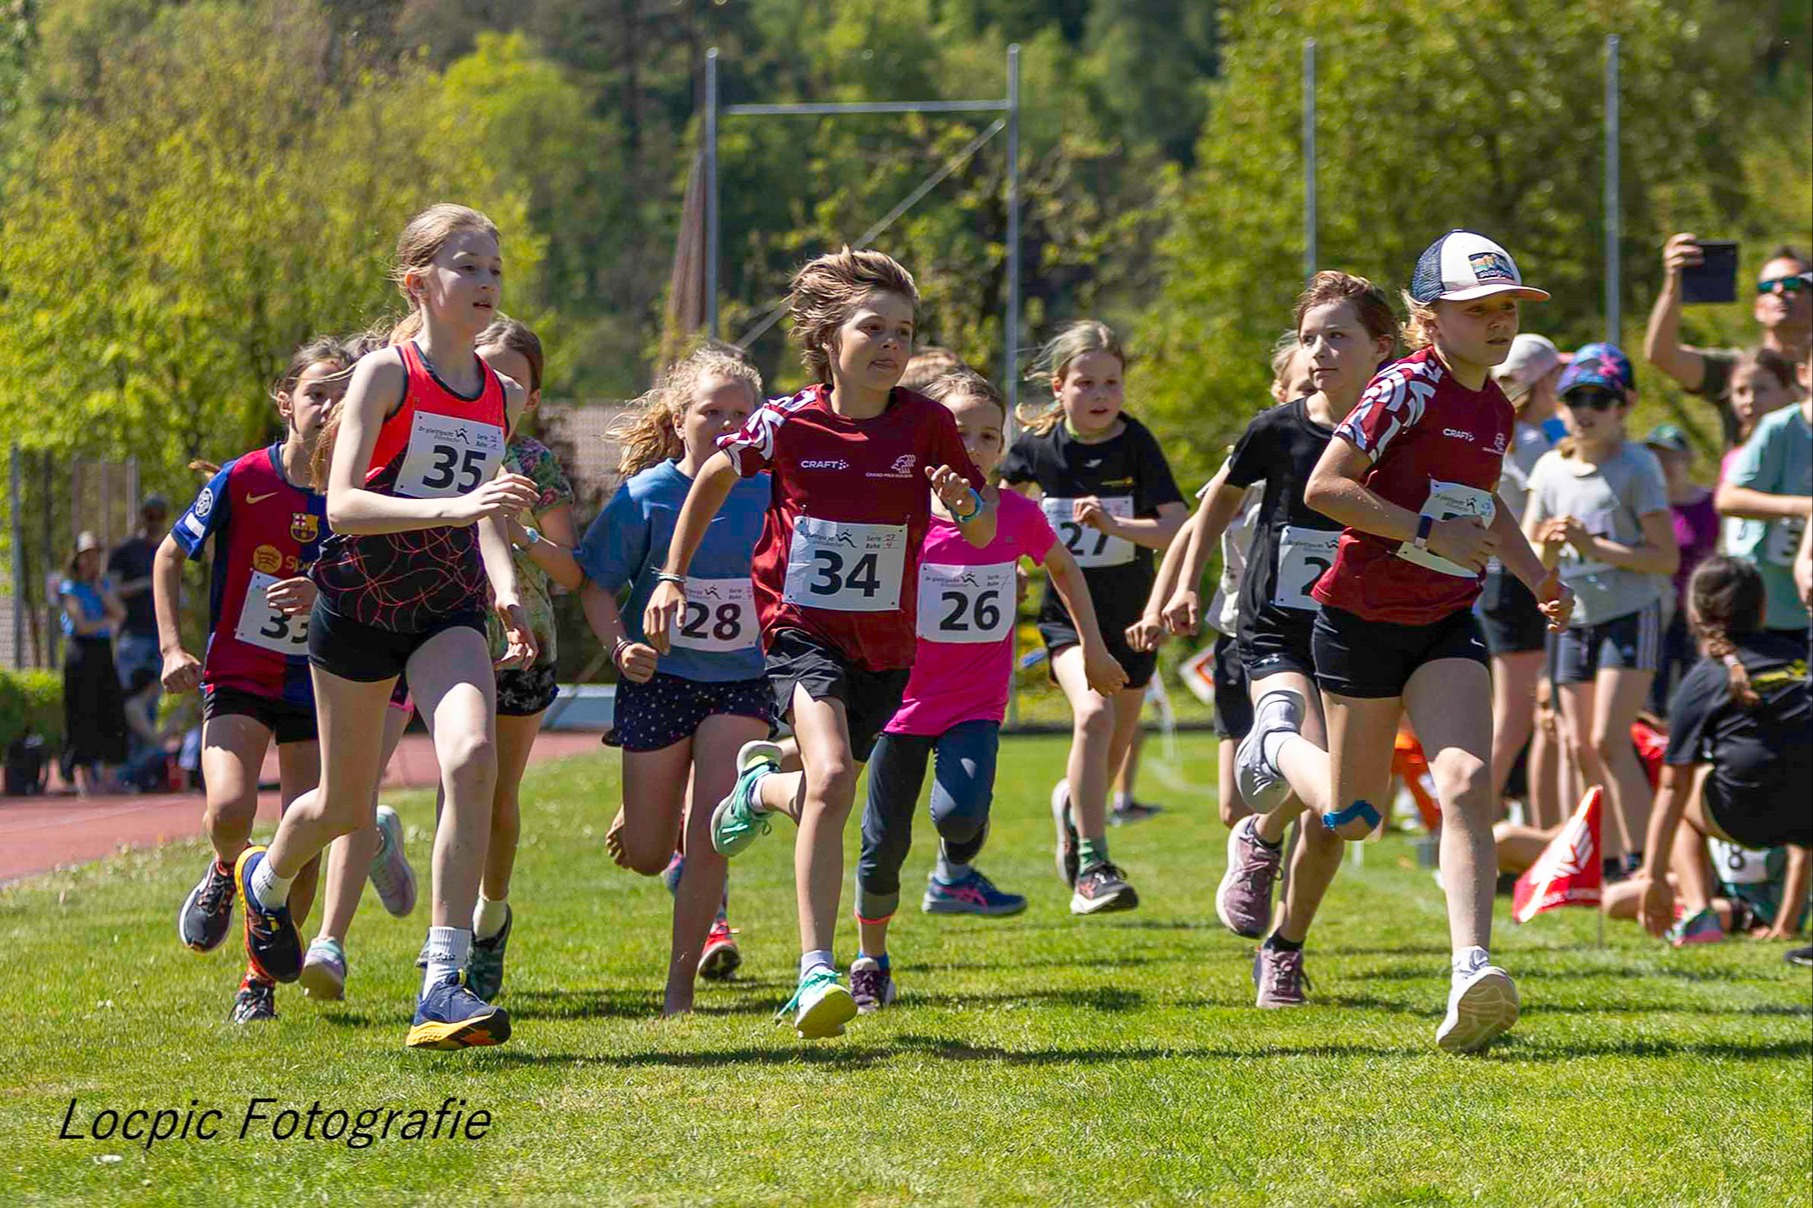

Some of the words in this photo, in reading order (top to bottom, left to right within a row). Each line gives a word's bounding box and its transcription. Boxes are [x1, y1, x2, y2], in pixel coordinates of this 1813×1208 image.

[422, 445, 486, 494] 35
[800, 460, 839, 469] CRAFT
[809, 549, 881, 597] 34
[680, 601, 742, 641] 28
[939, 590, 1000, 631] 26
